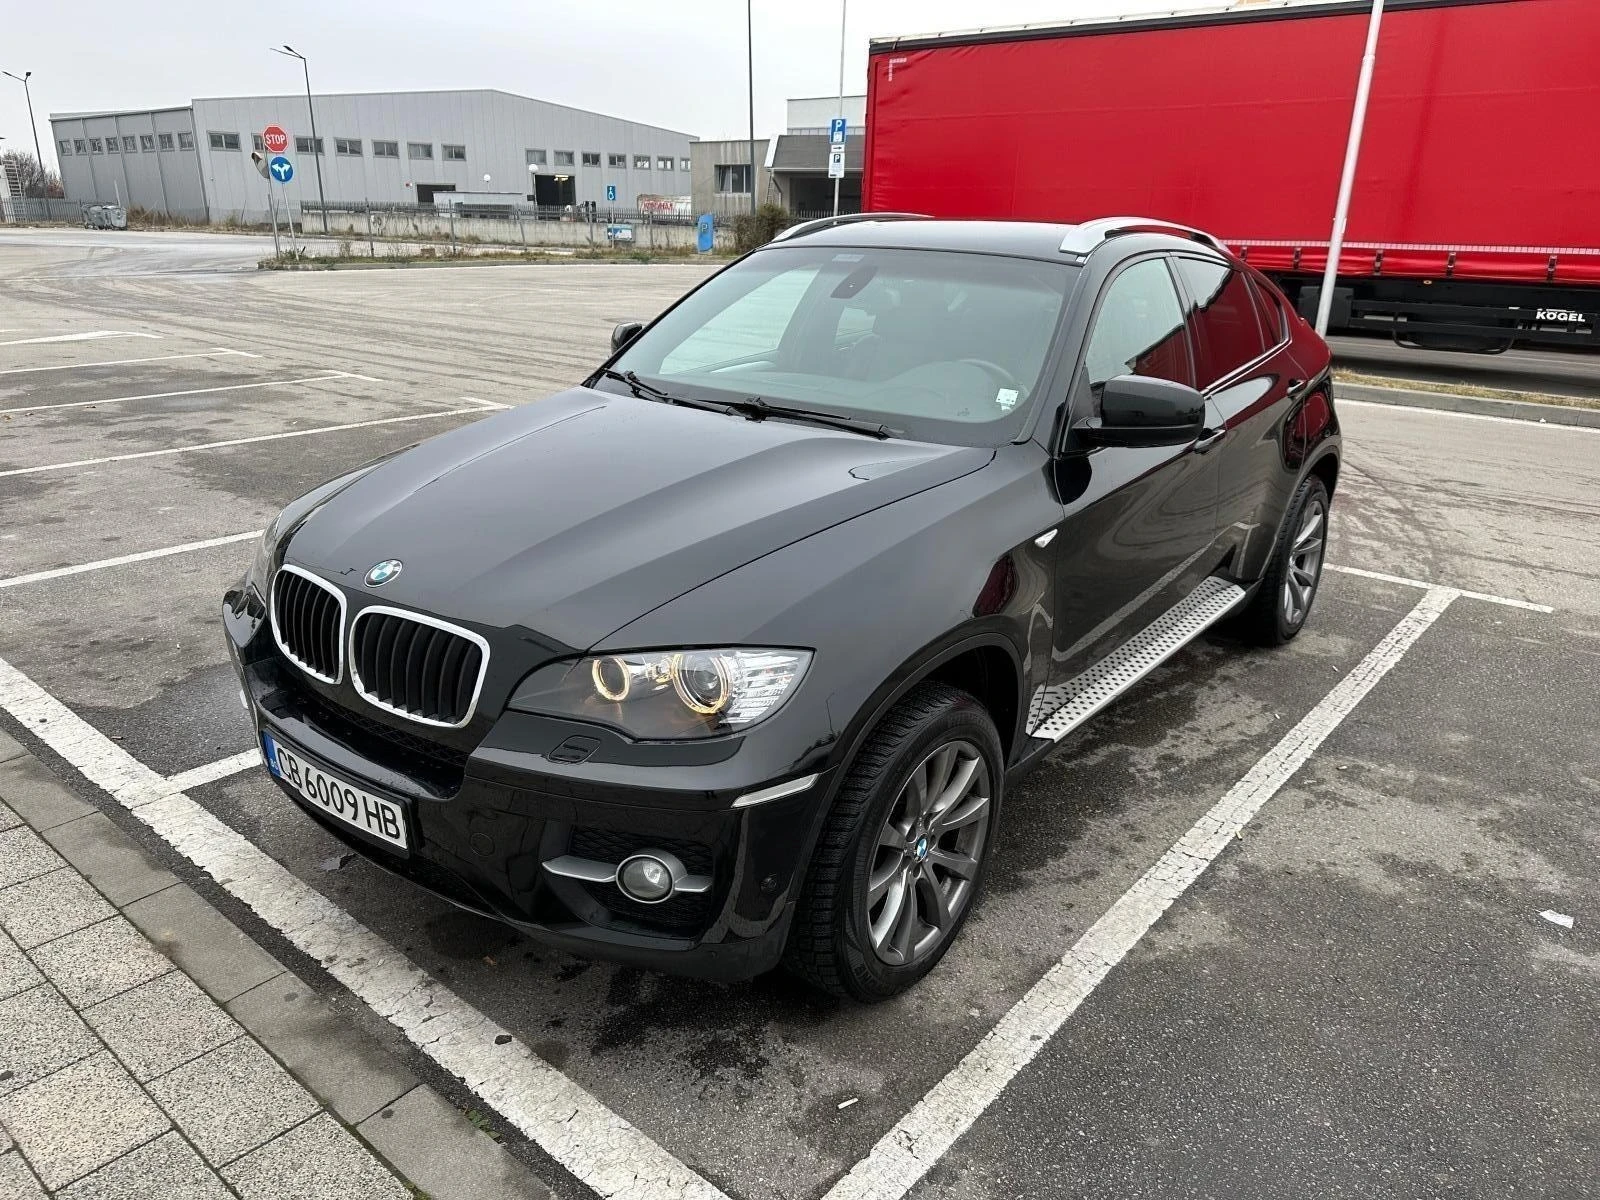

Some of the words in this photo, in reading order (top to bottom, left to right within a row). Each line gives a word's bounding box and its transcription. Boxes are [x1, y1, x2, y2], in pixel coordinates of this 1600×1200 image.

[265, 134, 286, 145] STOP
[1536, 311, 1586, 322] KÖGEL
[277, 747, 303, 789] CB
[304, 766, 359, 821] 6009
[361, 795, 401, 840] HB
